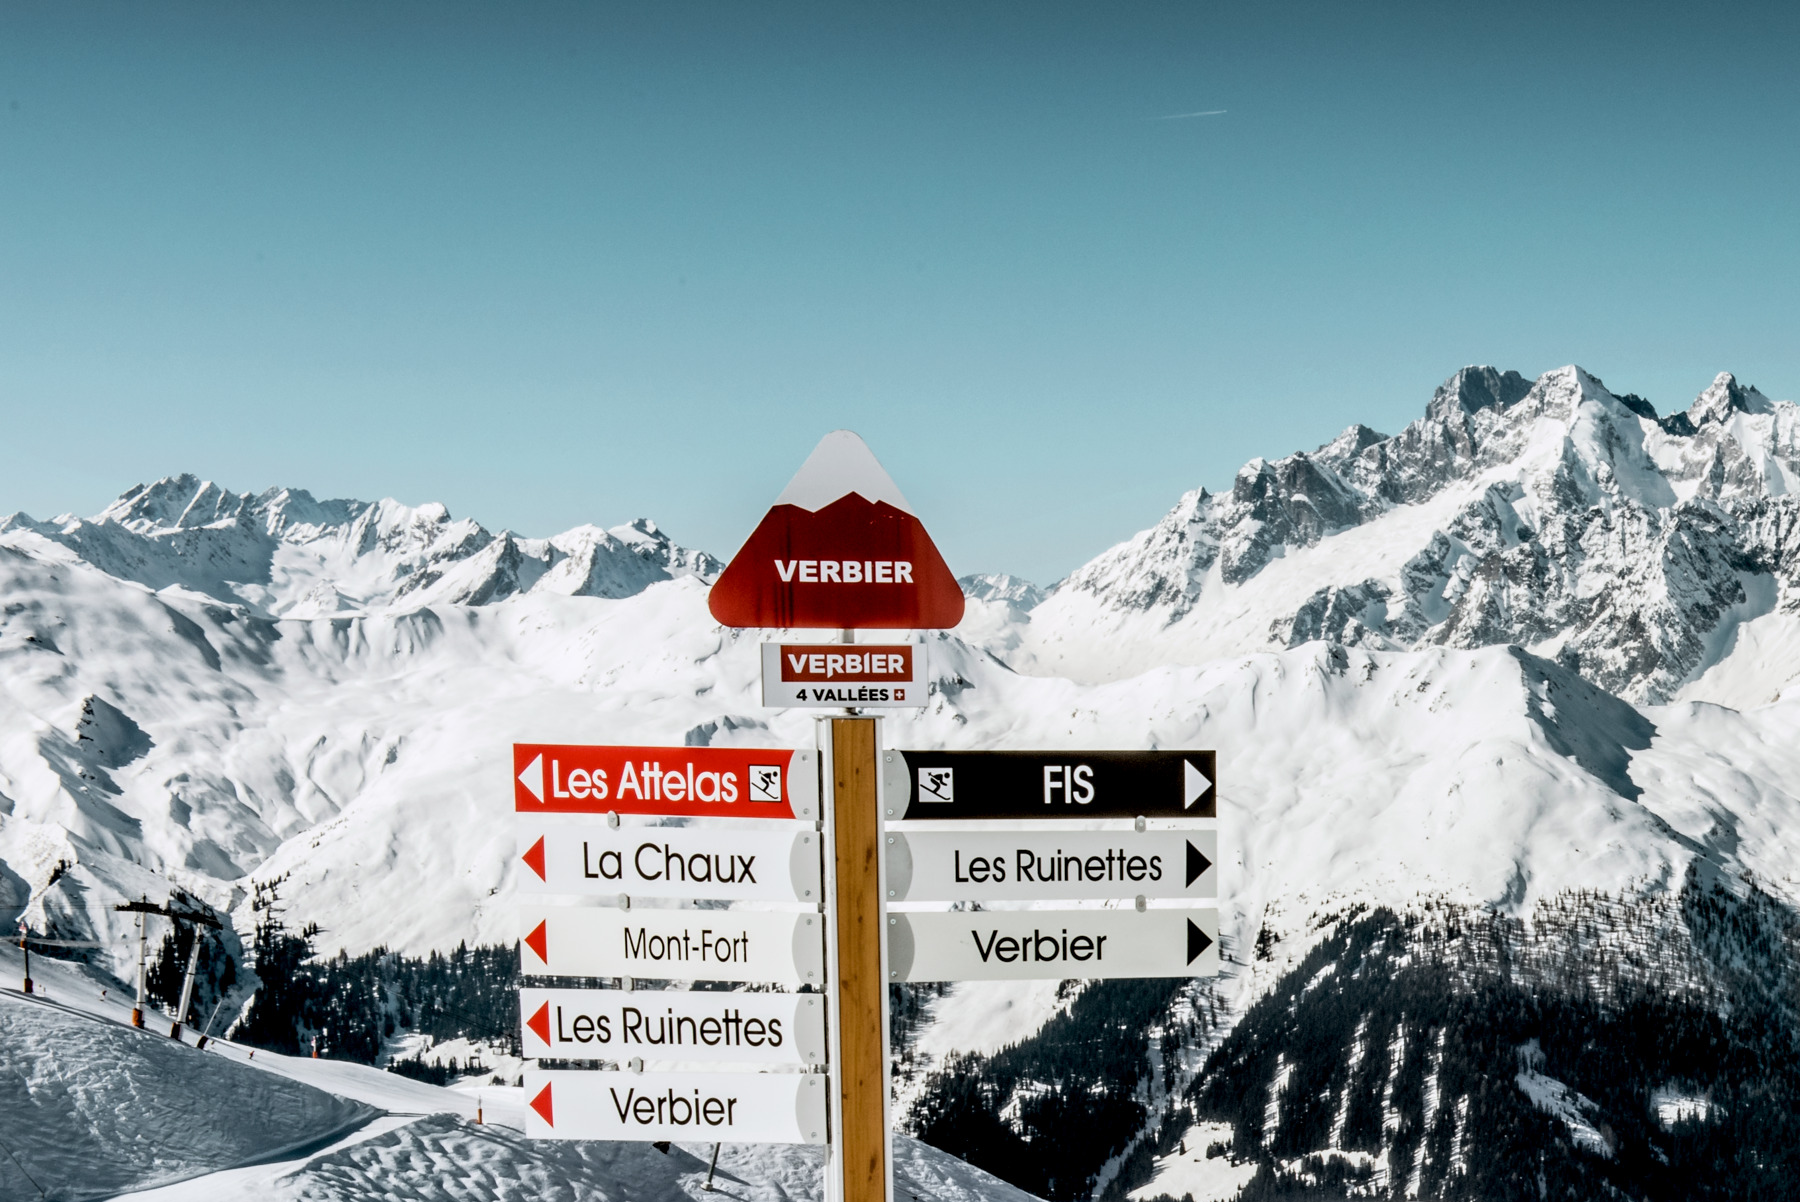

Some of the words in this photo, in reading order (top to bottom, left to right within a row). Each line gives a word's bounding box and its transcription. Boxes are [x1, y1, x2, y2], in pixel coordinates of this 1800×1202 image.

[774, 559, 914, 584] VERBIER
[787, 652, 905, 679] VERBIER
[796, 689, 808, 701] 4
[812, 685, 890, 702] VALLÉES
[552, 759, 609, 799] Les
[616, 760, 739, 804] Attelas
[1043, 764, 1095, 805] FIS
[583, 841, 623, 880] La
[634, 842, 757, 884] Chaux
[954, 849, 1006, 884] Les
[1016, 848, 1163, 883] Ruinettes
[623, 927, 749, 963] Mont-Fort
[970, 928, 1108, 963] Verbier
[557, 1005, 612, 1044] Les
[622, 1007, 783, 1048] Ruinettes
[609, 1087, 737, 1126] Verbier
